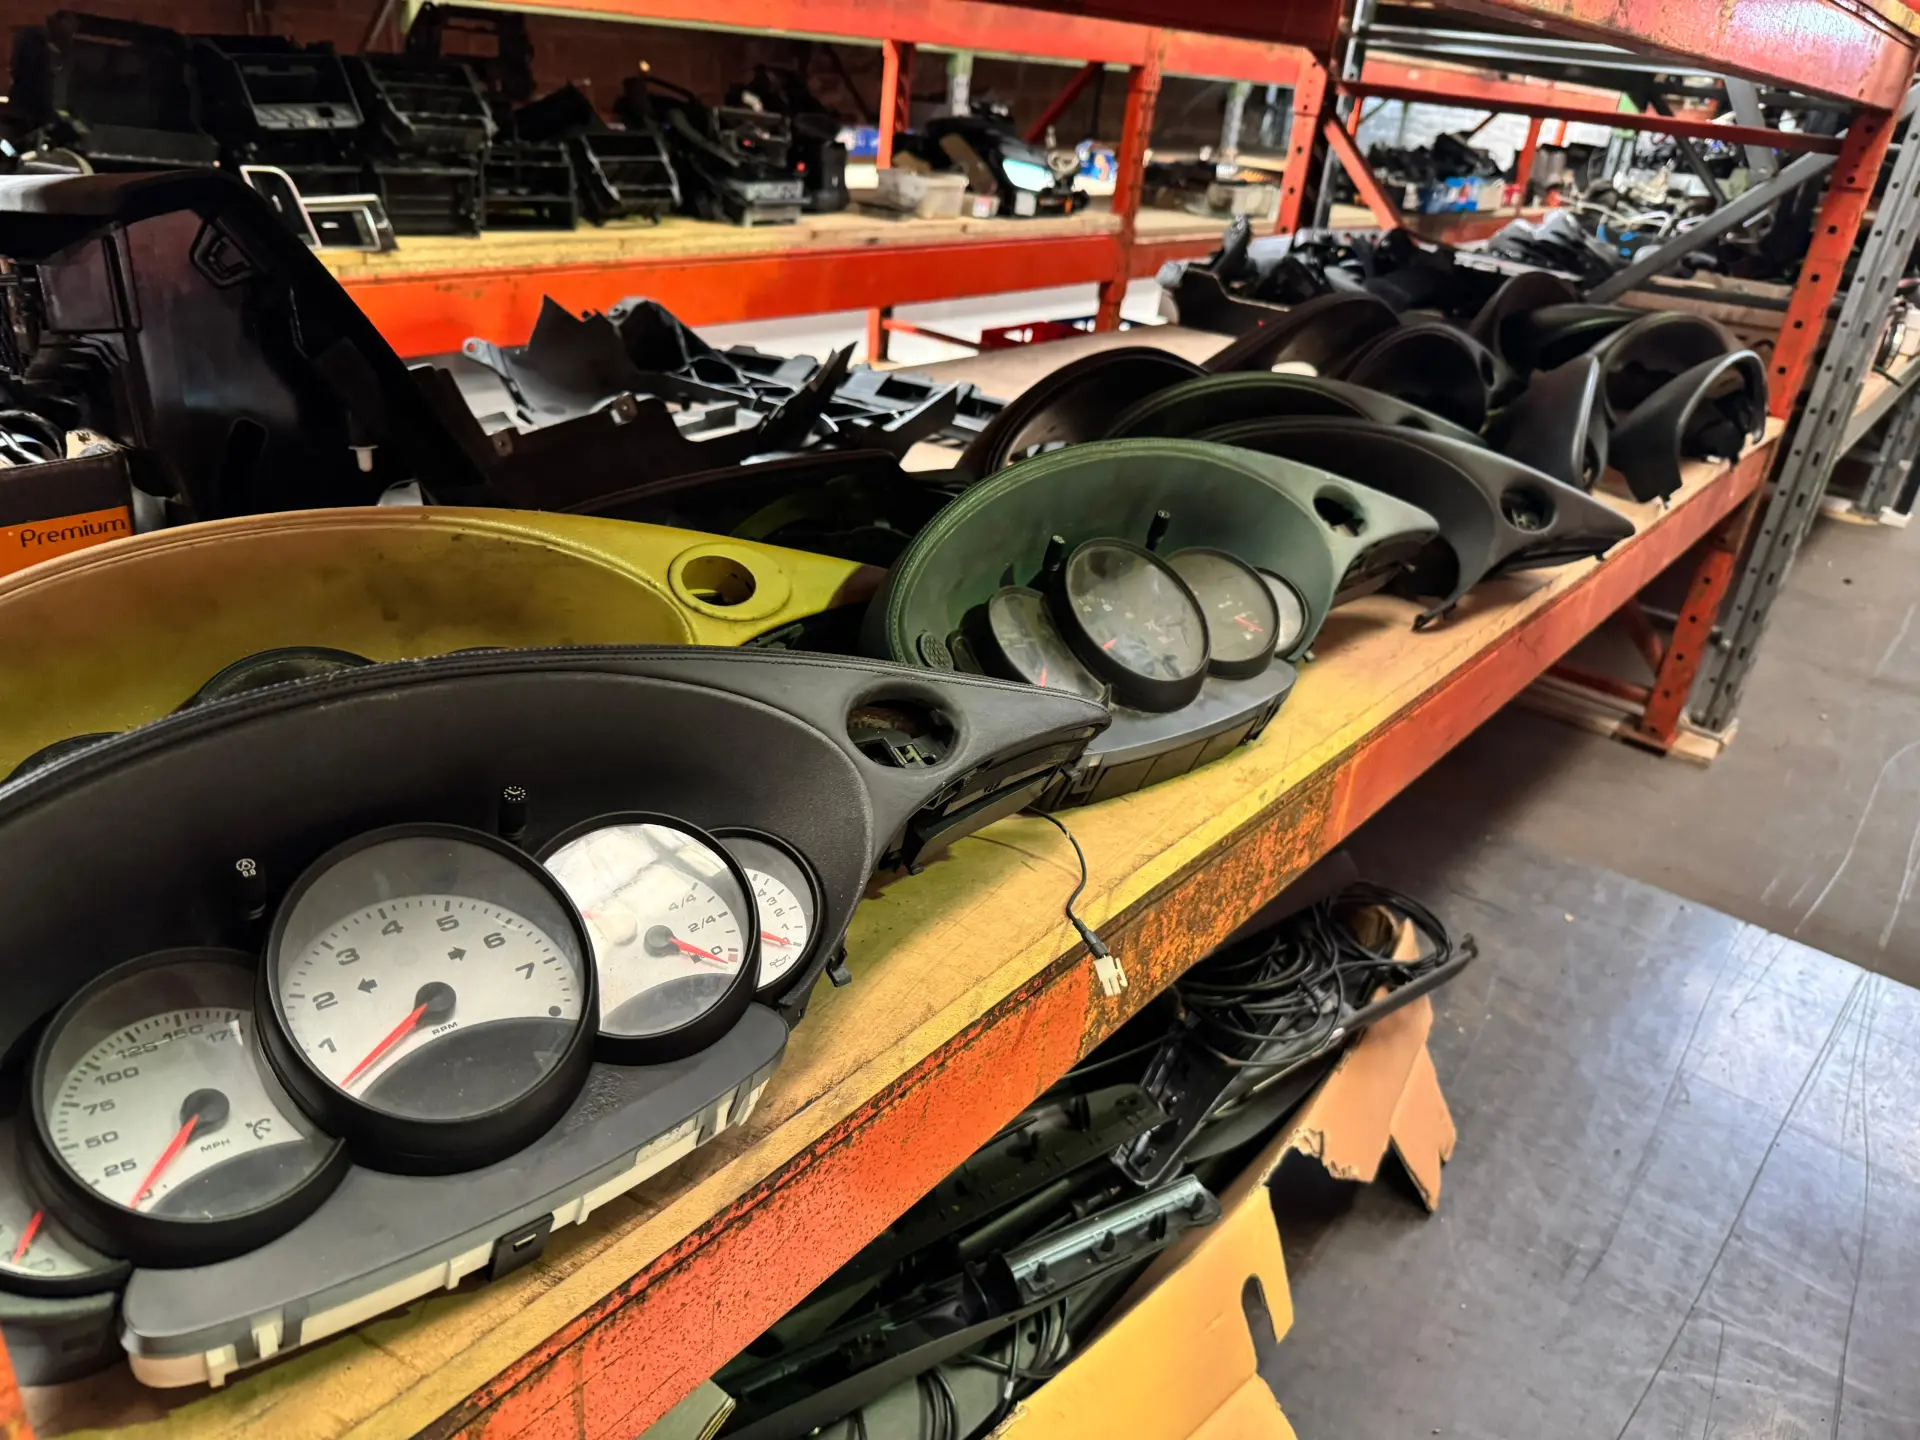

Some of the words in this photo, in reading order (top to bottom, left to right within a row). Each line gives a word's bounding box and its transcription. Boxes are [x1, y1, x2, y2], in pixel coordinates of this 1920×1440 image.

[20, 518, 126, 547] Premium
[757, 888, 767, 898] 4
[766, 896, 778, 906] 3
[669, 893, 697, 911] 4/4
[774, 907, 785, 918] 2
[381, 920, 404, 936] 4
[436, 915, 460, 931] 5
[688, 915, 716, 933] 2/4
[781, 923, 790, 931] 1
[483, 932, 505, 949] 6
[336, 948, 360, 966] 3
[711, 945, 723, 955] 0
[515, 962, 535, 980] 7
[312, 991, 338, 1011] 2
[163, 1024, 204, 1041] 150
[432, 1021, 458, 1036] RPM
[115, 1042, 159, 1060] 125
[318, 1037, 337, 1053] 1
[94, 1066, 139, 1086] 100
[83, 1099, 116, 1116] 75
[85, 1131, 118, 1149] 50
[200, 1138, 230, 1153] MPH
[104, 1158, 137, 1177] 25
